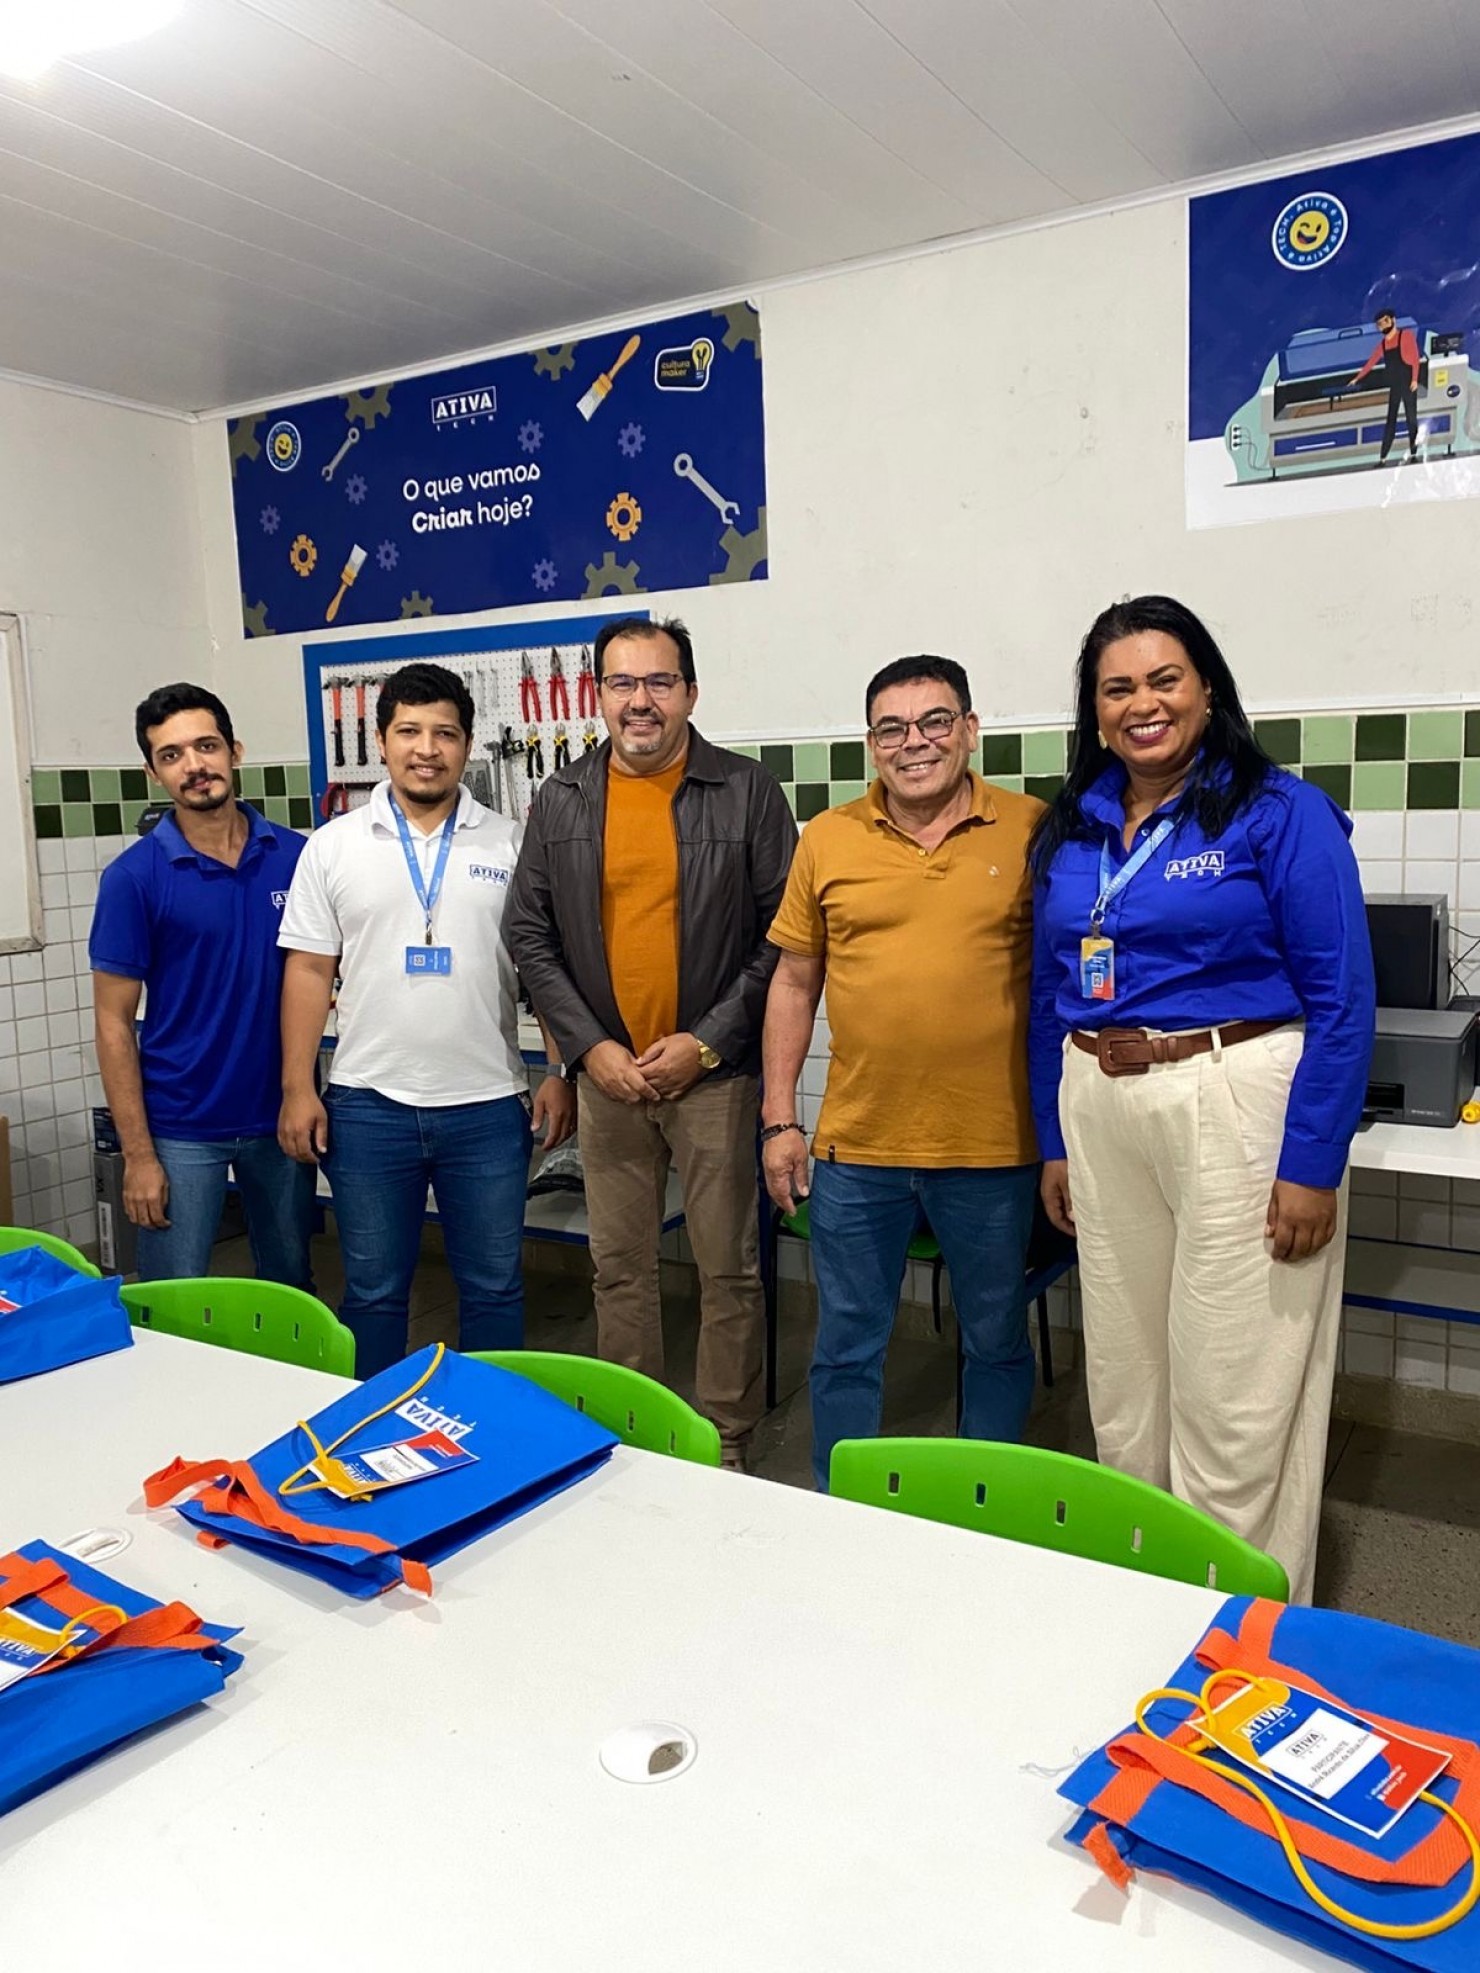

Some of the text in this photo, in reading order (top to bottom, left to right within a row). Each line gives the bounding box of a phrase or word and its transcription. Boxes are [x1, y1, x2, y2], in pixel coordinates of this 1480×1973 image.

[436, 392, 493, 419] ATIVA
[402, 463, 541, 502] O que vamos
[412, 494, 534, 533] Criar hoje?
[473, 866, 507, 881] ATIVA
[1168, 854, 1221, 873] ATIVA
[406, 1403, 466, 1436] ATIVA
[1241, 1706, 1287, 1739] ATIVA
[1291, 1732, 1320, 1755] ATIVA
